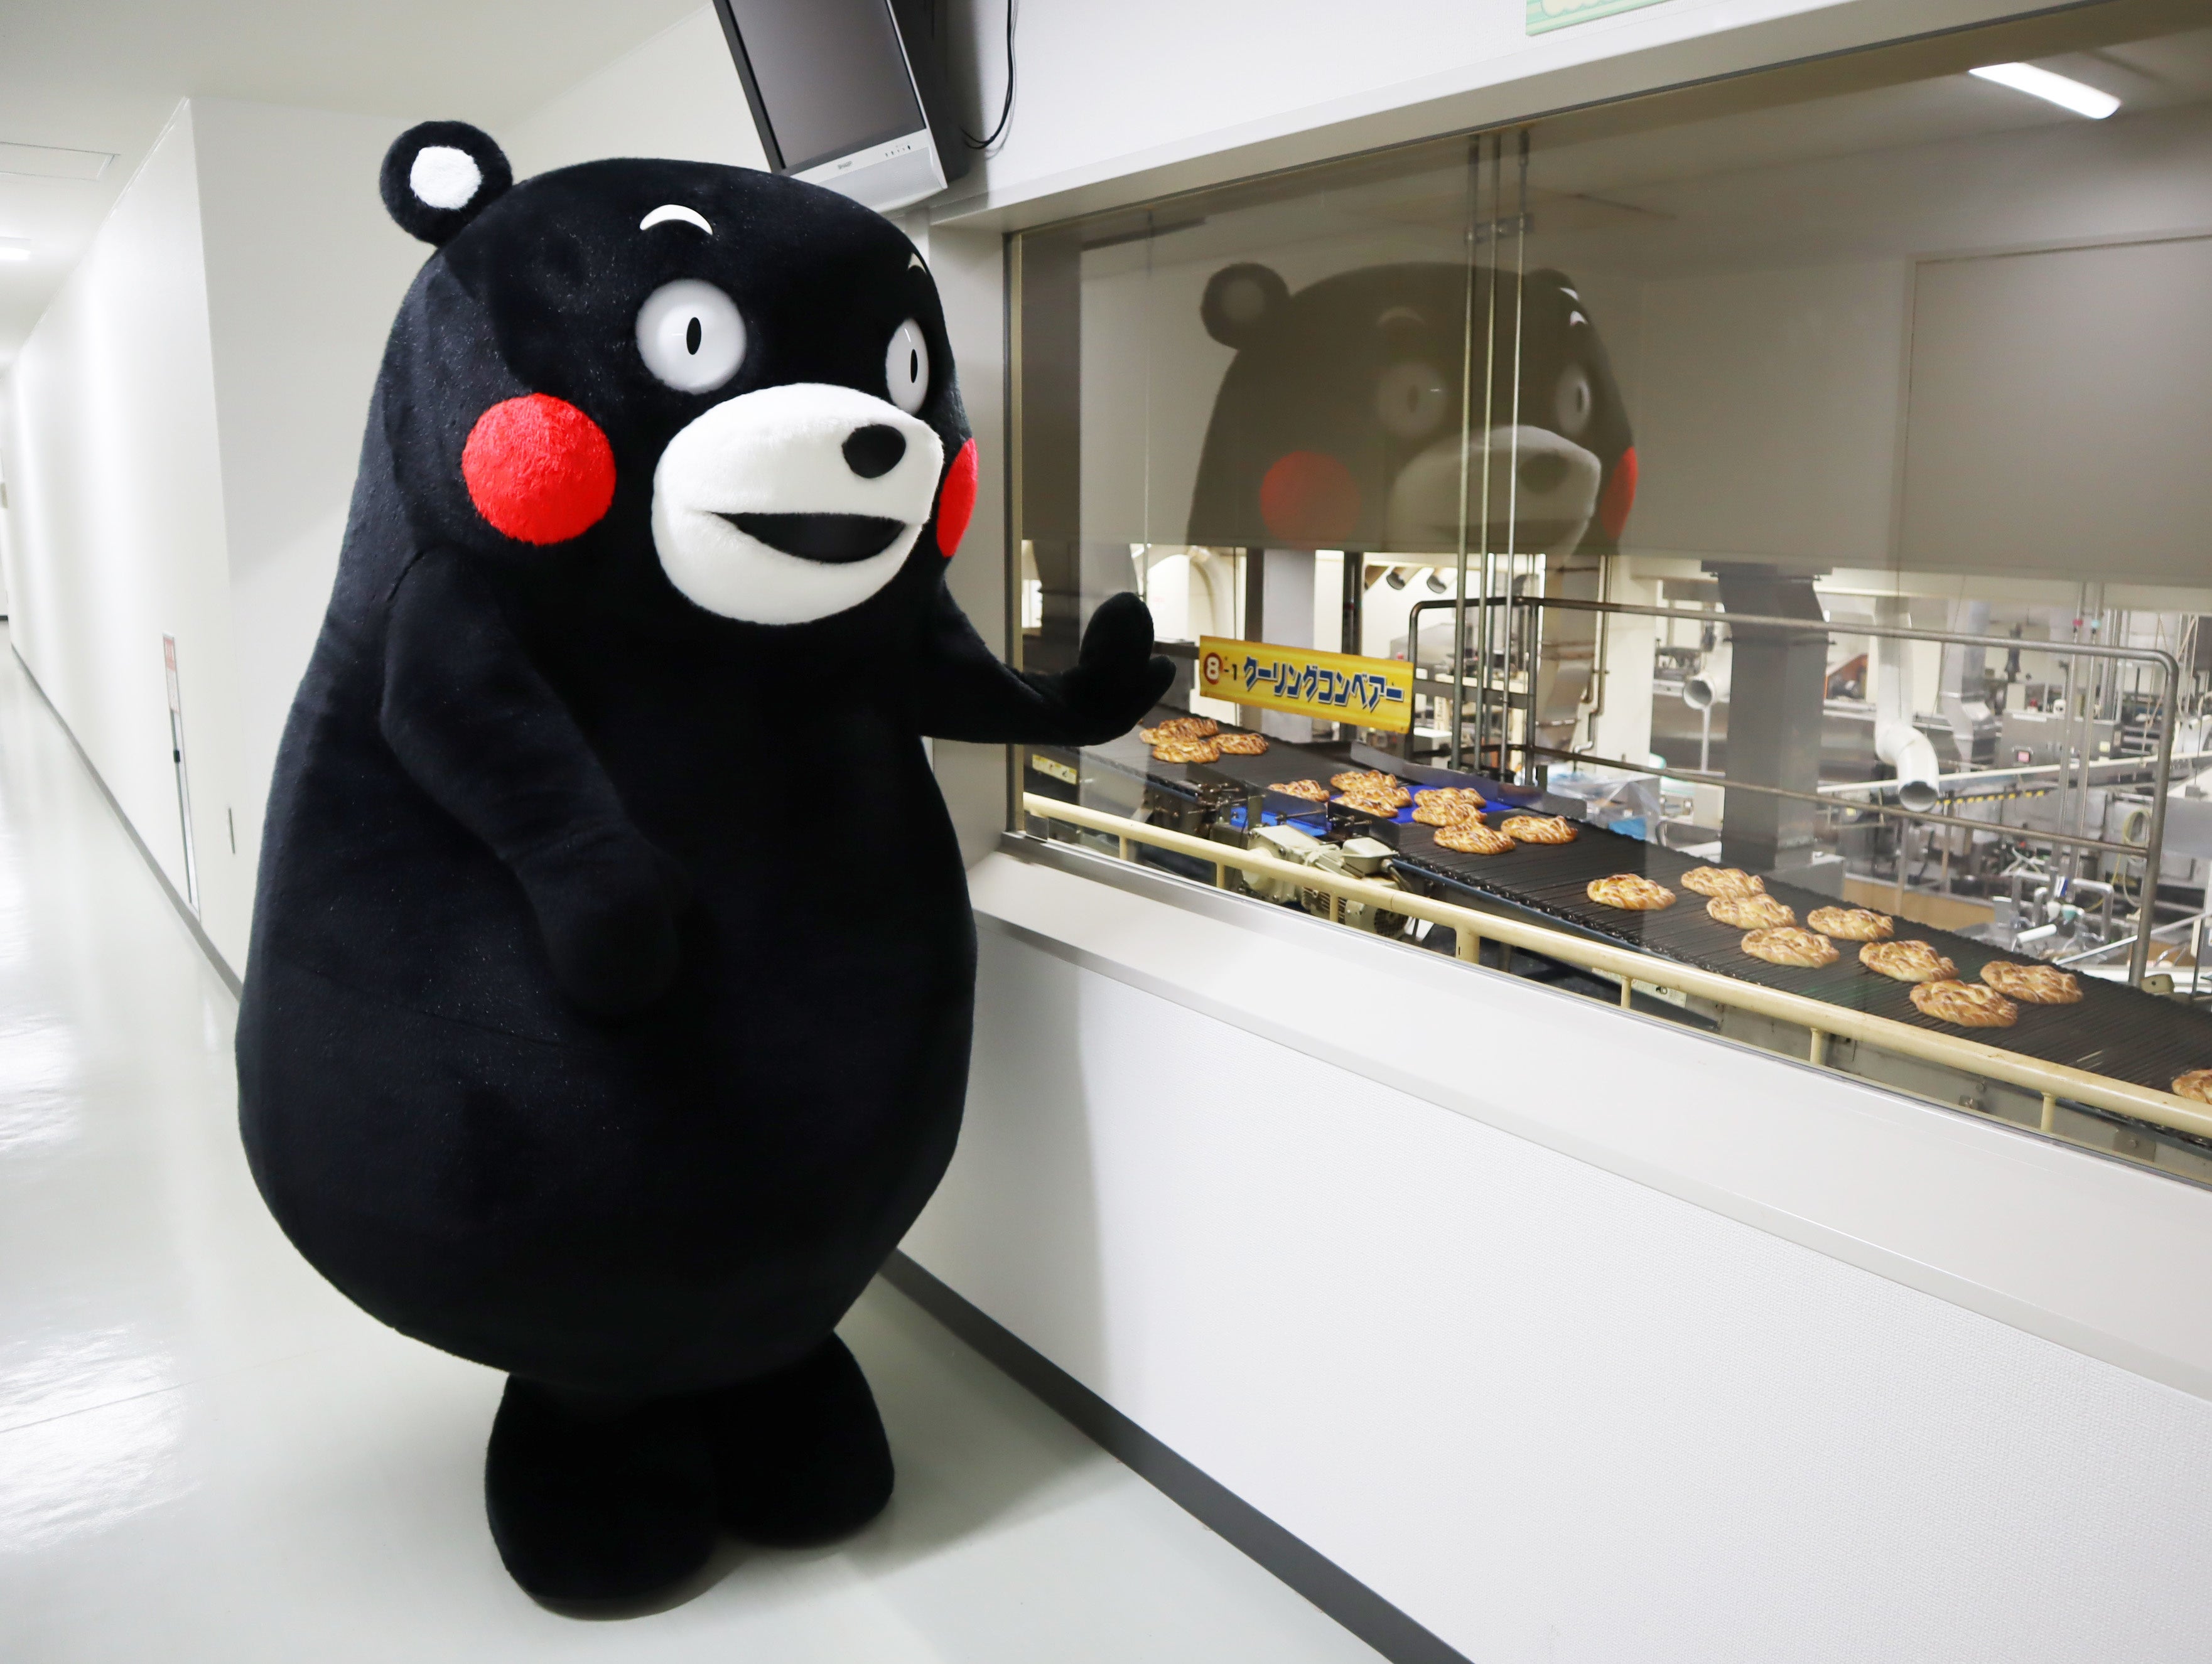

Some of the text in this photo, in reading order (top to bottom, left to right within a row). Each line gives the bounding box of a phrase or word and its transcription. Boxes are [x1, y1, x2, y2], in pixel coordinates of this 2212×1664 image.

[1244, 655, 1404, 712] クーリングコンベアー
